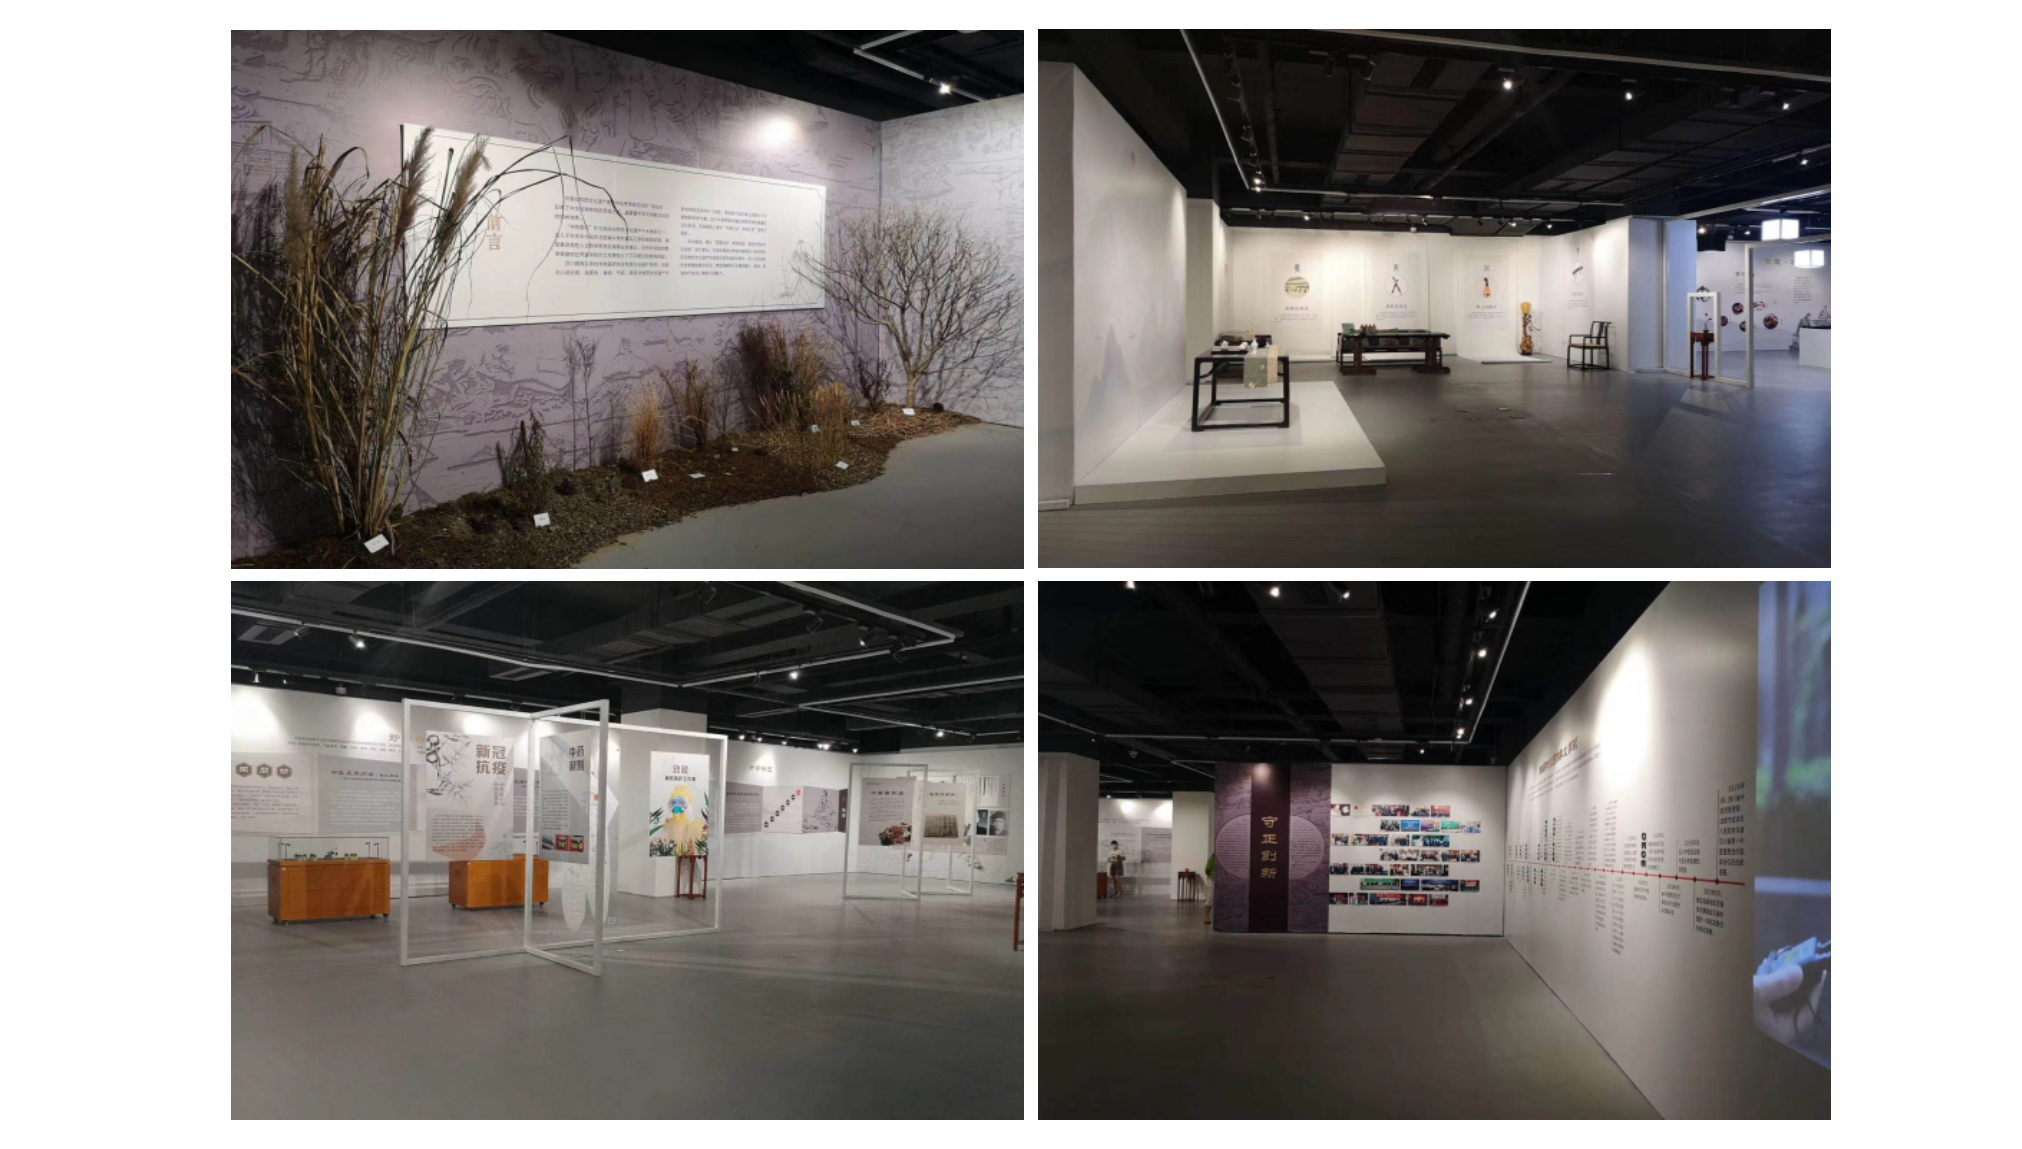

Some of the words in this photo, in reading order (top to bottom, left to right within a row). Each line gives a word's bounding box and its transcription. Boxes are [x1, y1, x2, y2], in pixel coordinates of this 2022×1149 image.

[486, 213, 503, 251] 前言
[476, 744, 507, 759] 新冠
[476, 760, 507, 775] 抗疫
